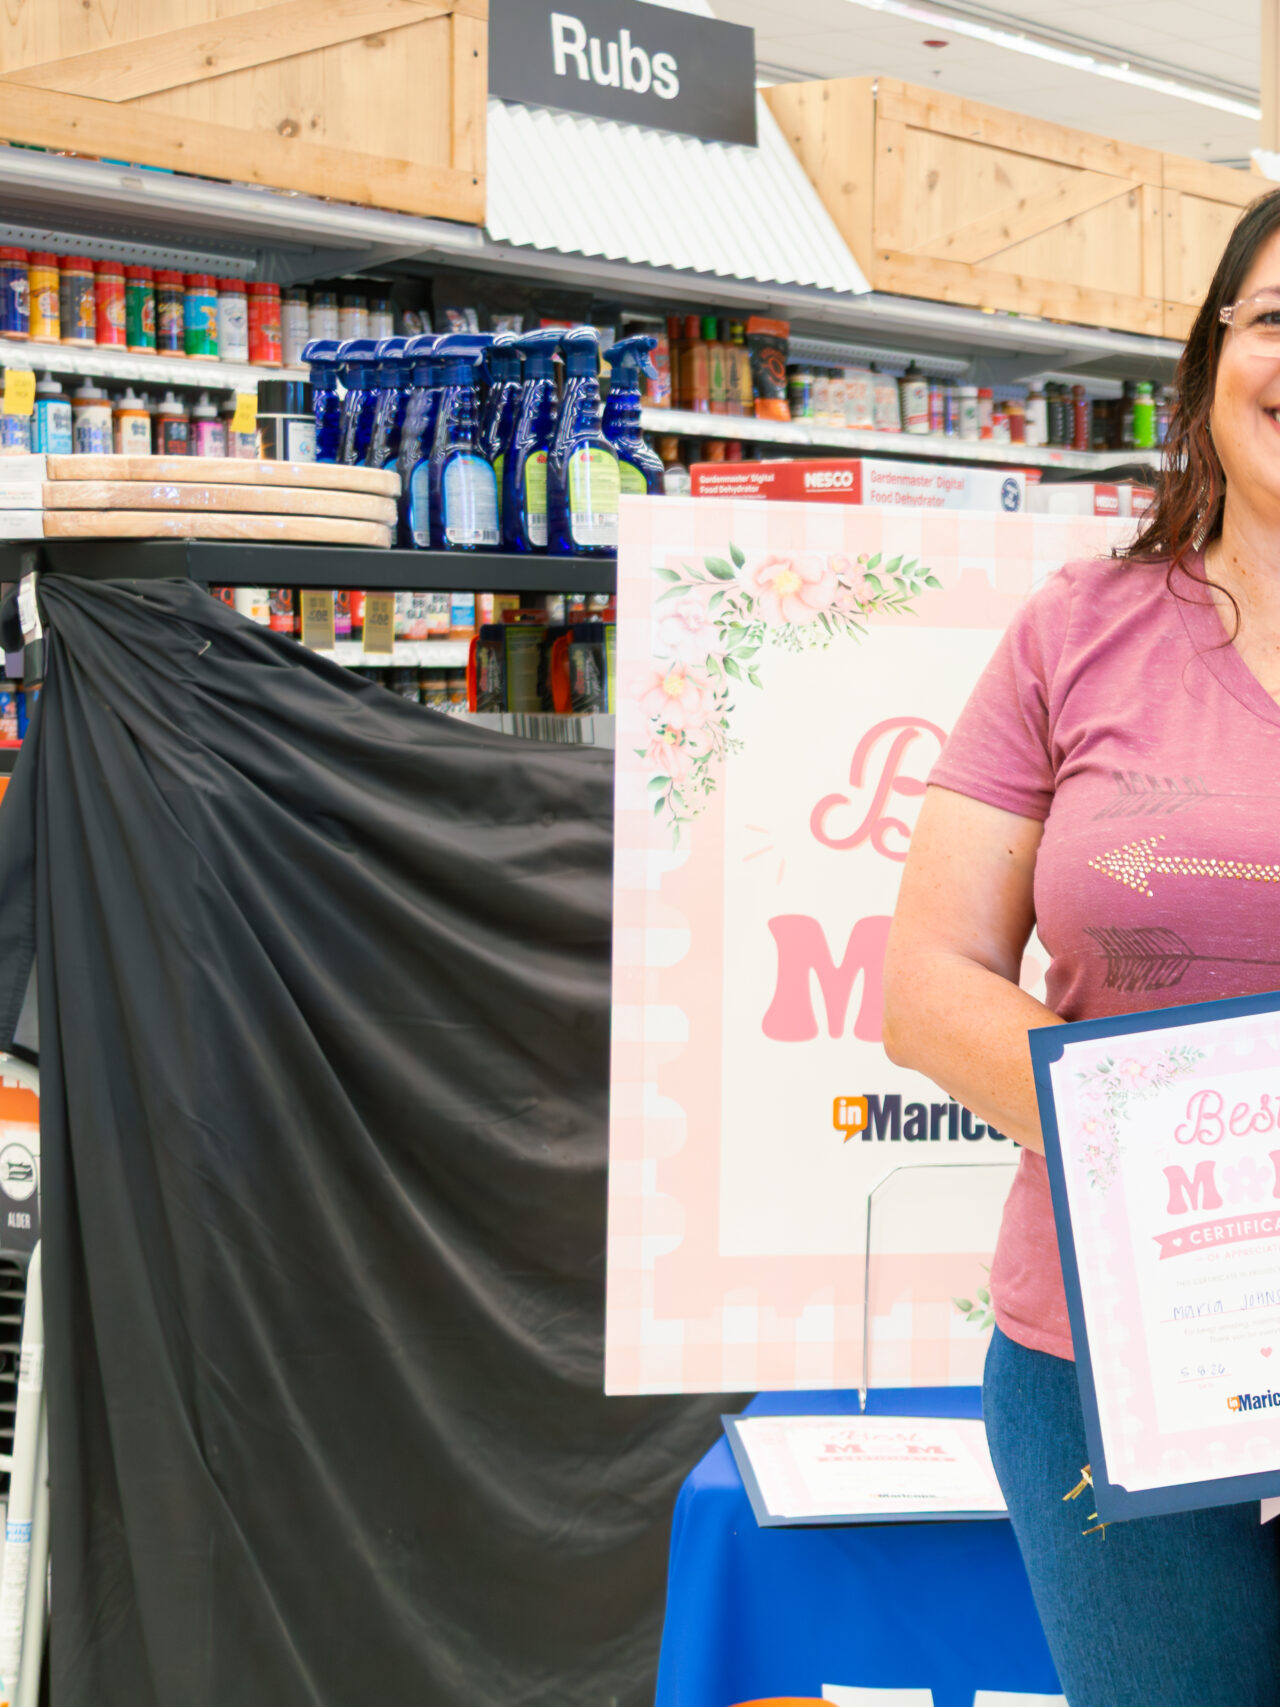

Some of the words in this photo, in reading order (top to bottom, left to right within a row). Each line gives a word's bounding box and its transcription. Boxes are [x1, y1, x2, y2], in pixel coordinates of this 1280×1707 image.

[550, 12, 680, 100] Rubs
[804, 471, 854, 489] NESCO
[936, 475, 965, 491] Digital
[870, 492, 893, 504] Food
[895, 492, 946, 508] Dehydrator
[8, 1211, 31, 1230] ALDER
